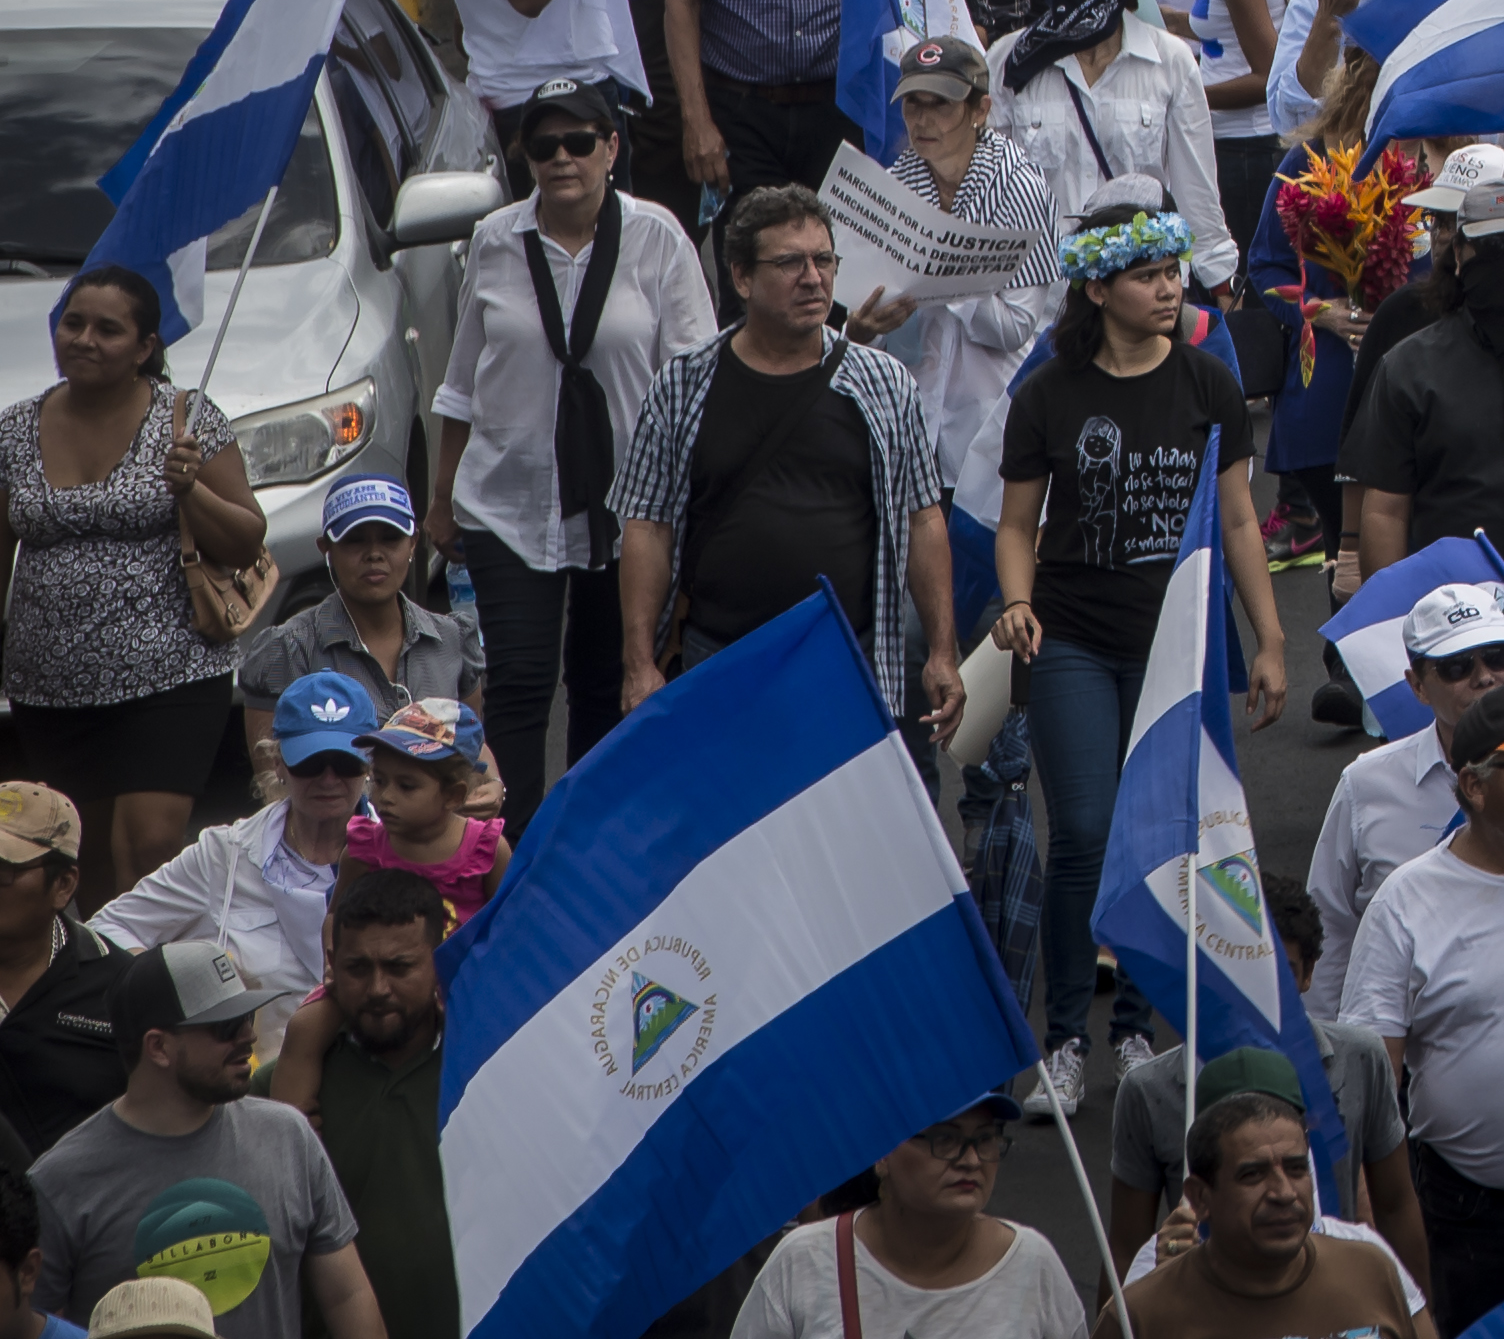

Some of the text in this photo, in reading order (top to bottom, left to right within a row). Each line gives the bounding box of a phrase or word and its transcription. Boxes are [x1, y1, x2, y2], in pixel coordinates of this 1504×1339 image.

[917, 43, 944, 67] C
[829, 184, 1022, 266] MARCHAMOS POR LA DEMOCRACIA
[837, 165, 1029, 255] MARCHAMOS POR LA JUSTICIA
[885, 243, 907, 266] POR
[905, 258, 924, 275] LA
[923, 258, 1017, 277] LIBERTAD
[146, 1229, 262, 1265] BILLABONG
